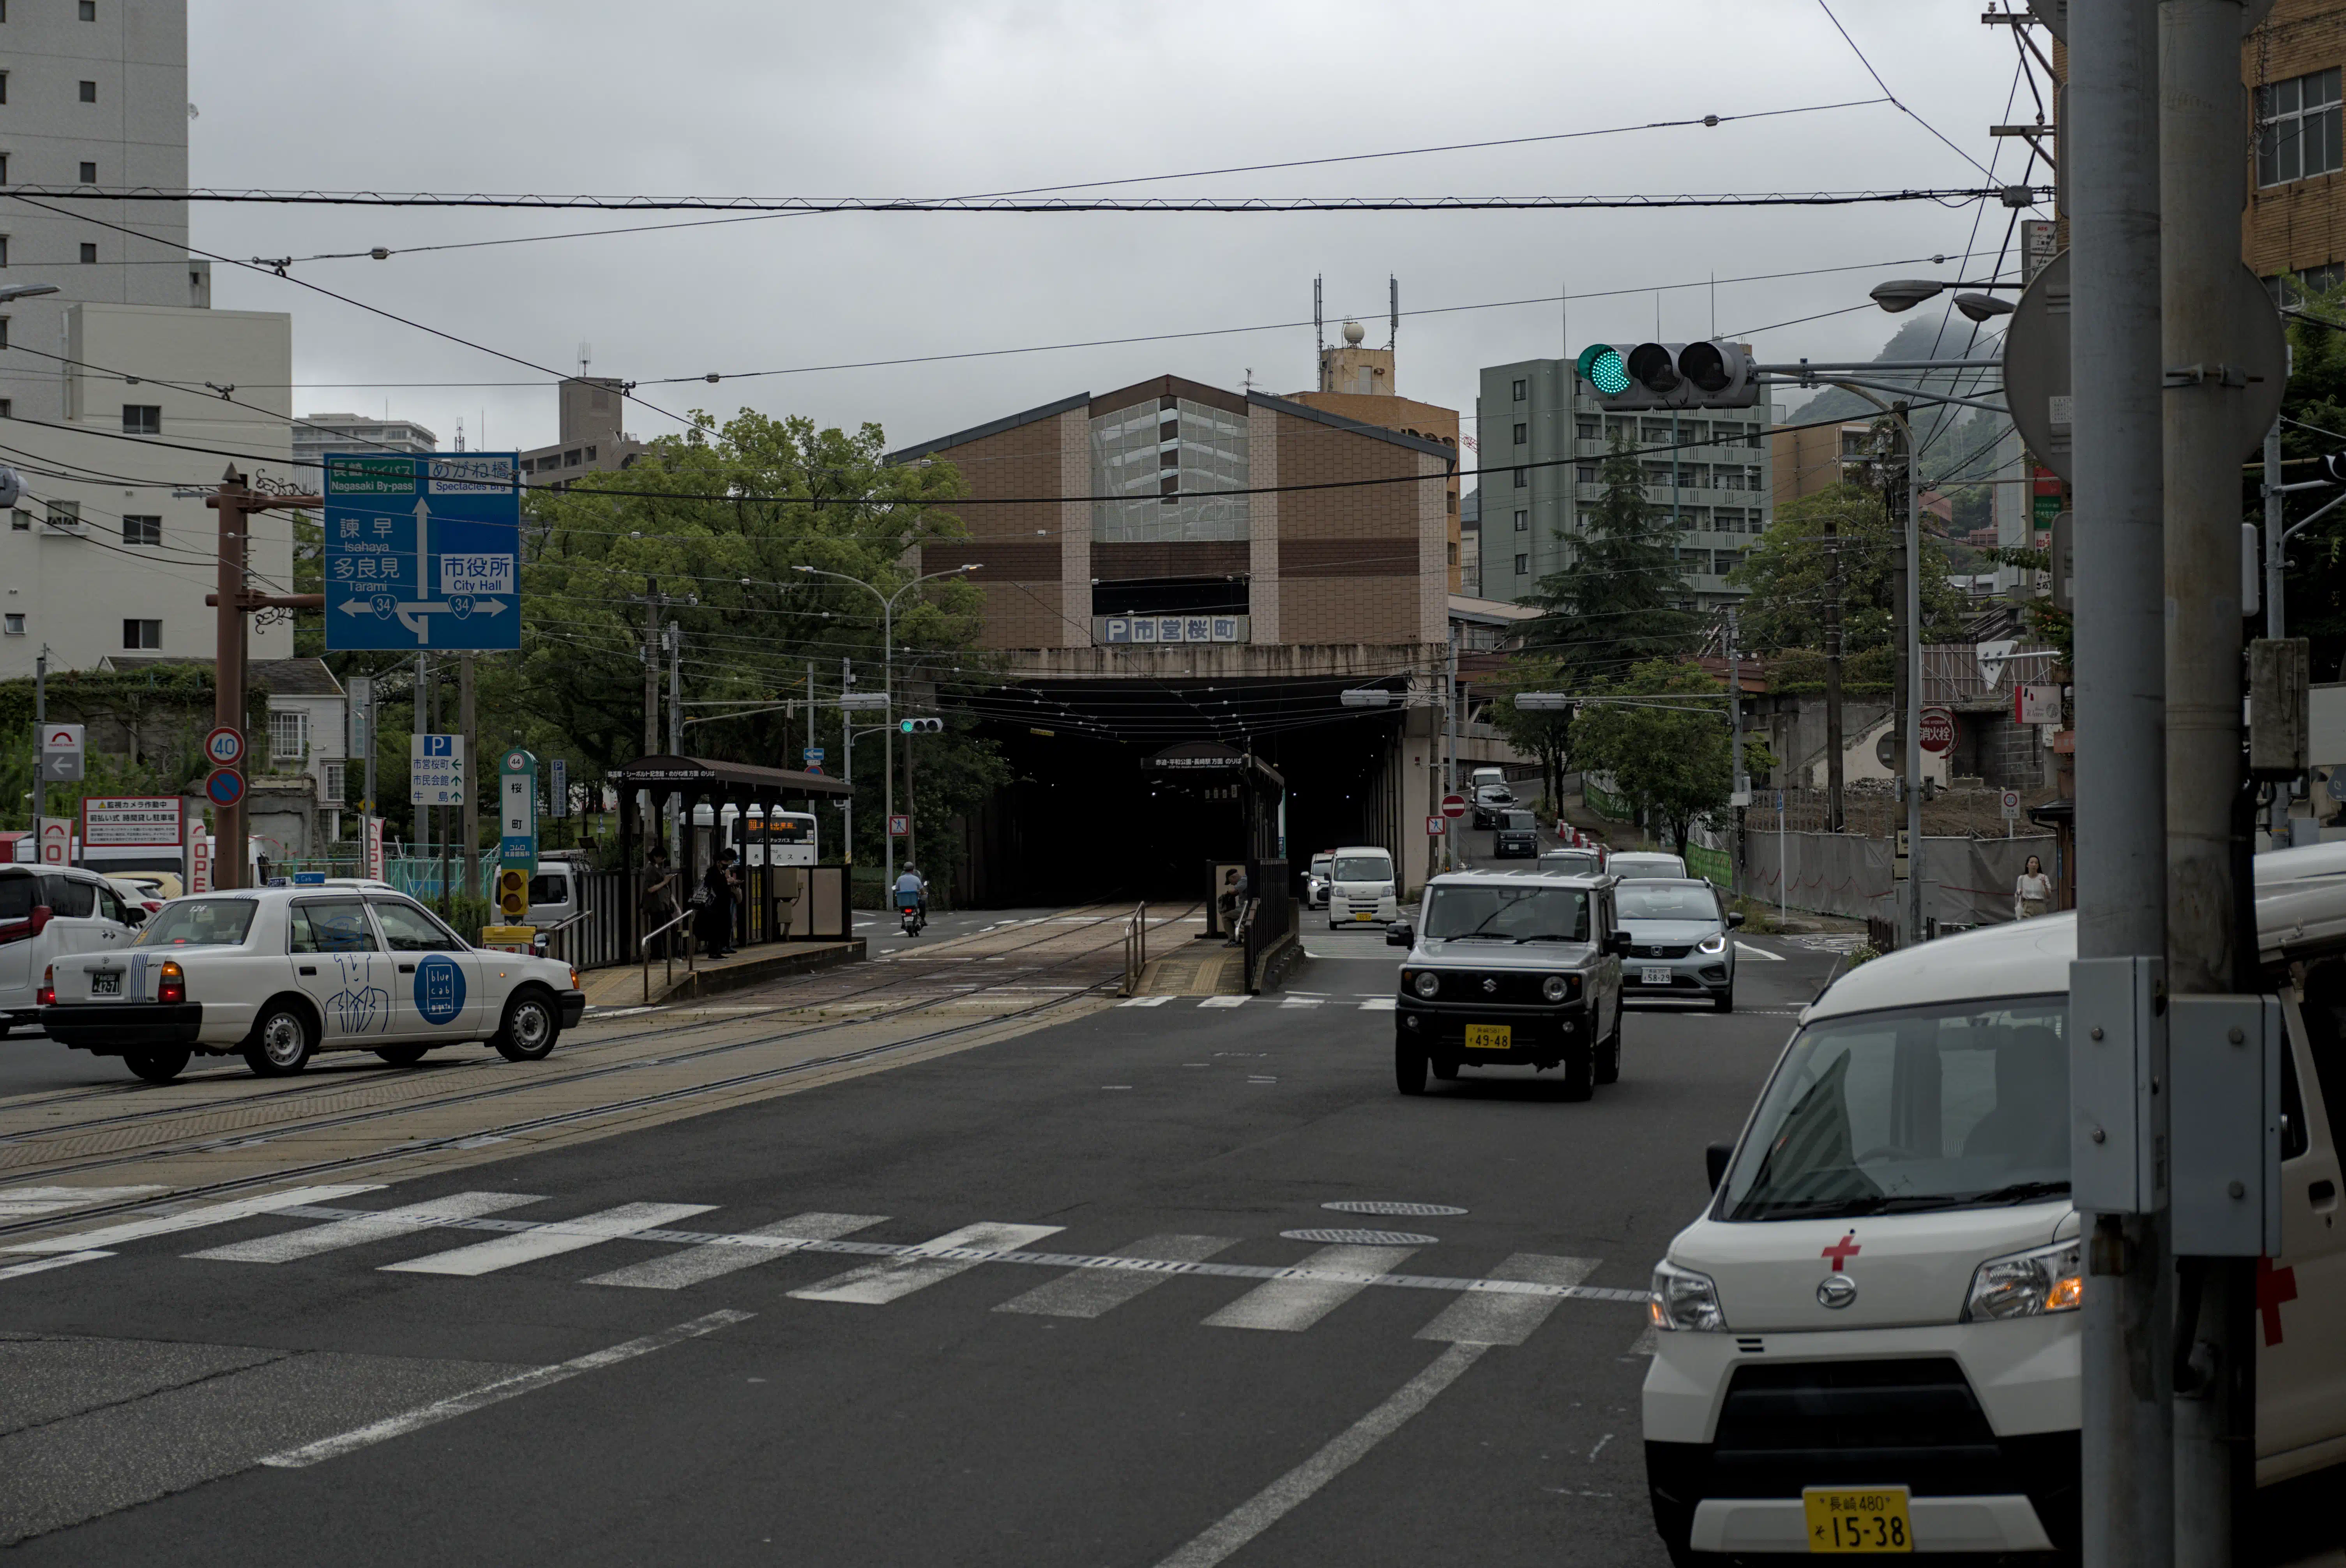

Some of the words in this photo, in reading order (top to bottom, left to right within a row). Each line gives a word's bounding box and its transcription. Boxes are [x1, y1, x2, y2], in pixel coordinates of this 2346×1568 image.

[333, 462, 411, 477] 長崎バイパス
[433, 461, 509, 479] めがね橋
[331, 482, 375, 491] Nagasaki
[376, 482, 413, 492] By-pass
[436, 482, 486, 492] Spectacles
[340, 518, 393, 538] 諫早
[345, 542, 389, 554] Isahaya
[334, 557, 400, 579] 多良見
[444, 557, 511, 577] 市役所
[349, 581, 387, 592] Tarami
[454, 580, 475, 593] City
[480, 580, 502, 591] Hall
[377, 598, 390, 611] 34
[455, 598, 469, 611] 34
[1108, 620, 1127, 641] P
[1134, 620, 1235, 640] 市営桜町
[1920, 726, 1950, 741] 消火栓
[214, 738, 235, 755] 40
[432, 736, 445, 756] P
[413, 758, 449, 770] 市営桜町
[413, 775, 449, 786] 市民会館
[413, 791, 449, 802] 牛島
[511, 783, 522, 830] 桜町
[431, 970, 449, 982] blue
[431, 985, 450, 995] cab
[1475, 1035, 1508, 1047] 49-48
[1830, 1496, 1884, 1511] 長崎480
[1815, 1524, 1825, 1540] そ
[1833, 1516, 1905, 1547] 15-38
